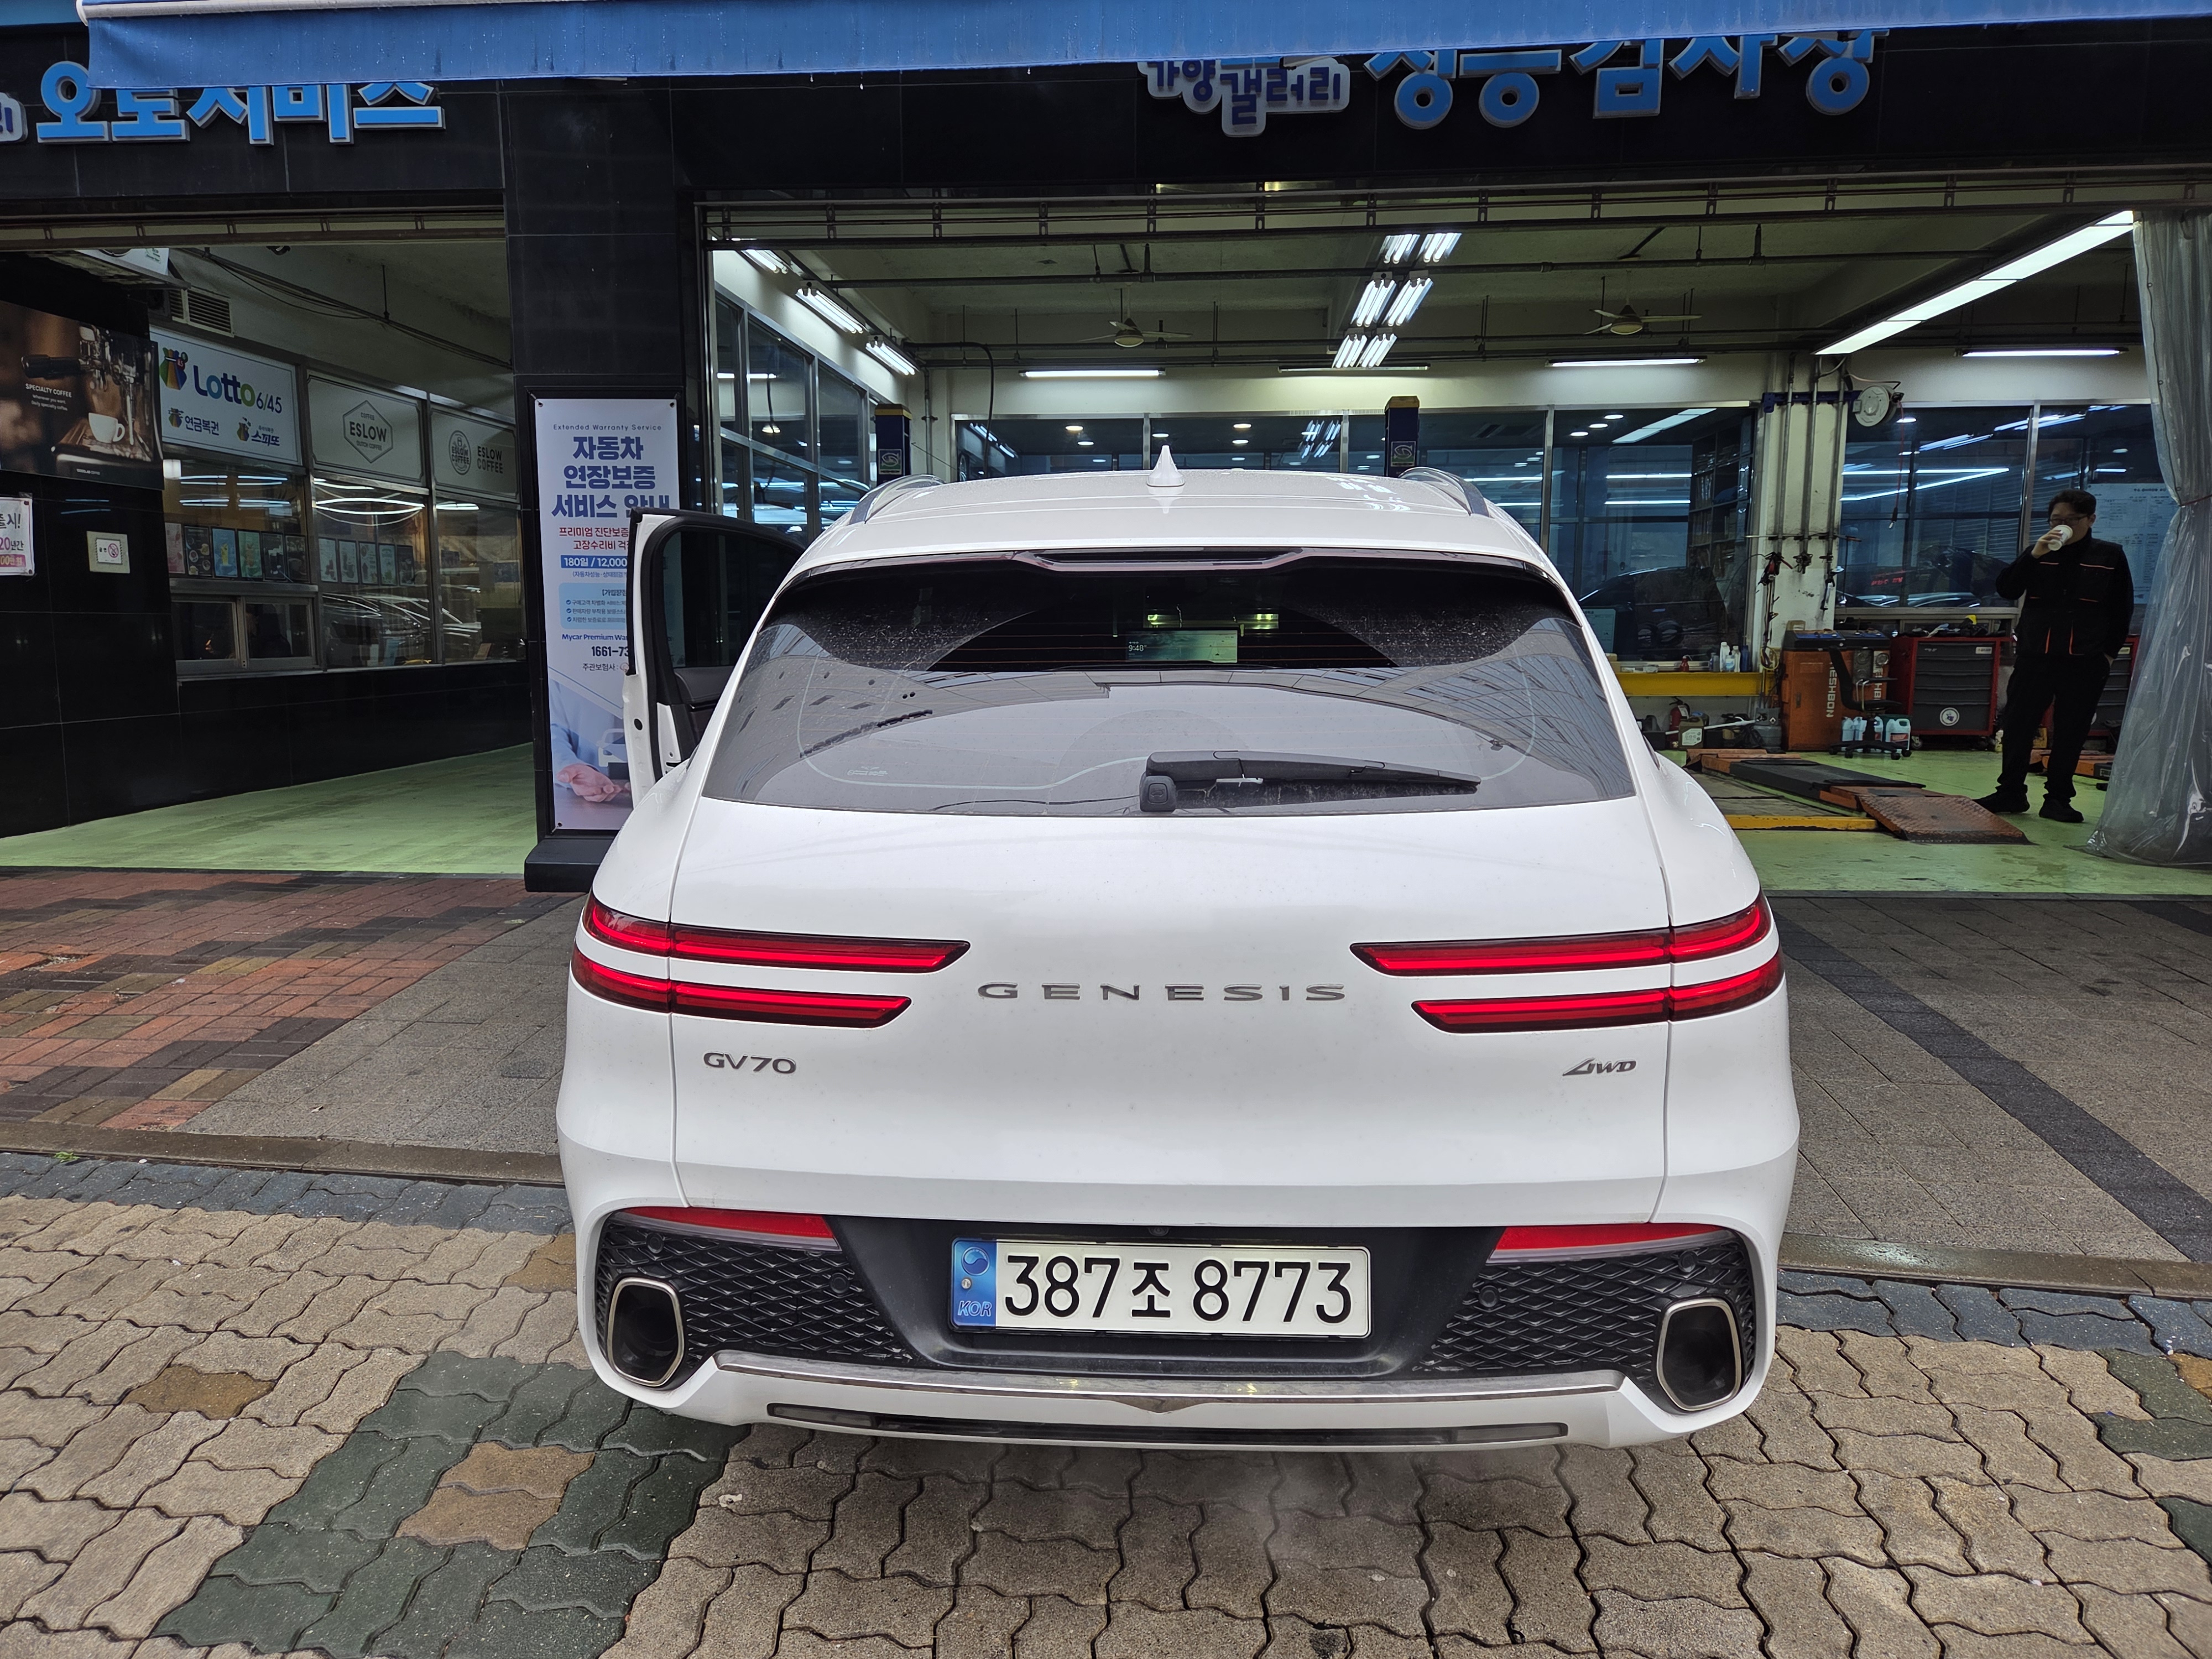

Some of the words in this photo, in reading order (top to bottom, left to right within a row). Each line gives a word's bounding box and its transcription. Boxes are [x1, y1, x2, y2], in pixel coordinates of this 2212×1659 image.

[25, 383, 52, 393] SPECIALTY
[53, 389, 72, 398] COFFEE
[193, 365, 256, 407] Lotto
[256, 392, 283, 414] 6/45
[184, 415, 220, 436] 연금복권
[349, 421, 387, 442] ESLOW
[251, 430, 280, 447] 스피또
[572, 436, 644, 460] 자동차
[451, 446, 468, 457] ESLOW
[451, 454, 469, 465] COFFEE
[477, 446, 502, 461] ESLOW
[477, 458, 503, 474] COFFEE
[564, 465, 656, 489] 연장보증
[551, 494, 618, 518] 서비스
[559, 527, 593, 537] 프리미엄
[573, 540, 616, 550] 고장수리비
[618, 540, 629, 550] 걱
[564, 557, 588, 567] 180일
[1825, 661, 1838, 718] ESHBON
[977, 981, 1346, 1001] GENESIS
[703, 1051, 797, 1074] GV70
[1562, 1057, 1637, 1077] 4WD
[1005, 1254, 1172, 1319] 387조
[1192, 1258, 1352, 1324] 8773
[957, 1300, 993, 1317] KOR
